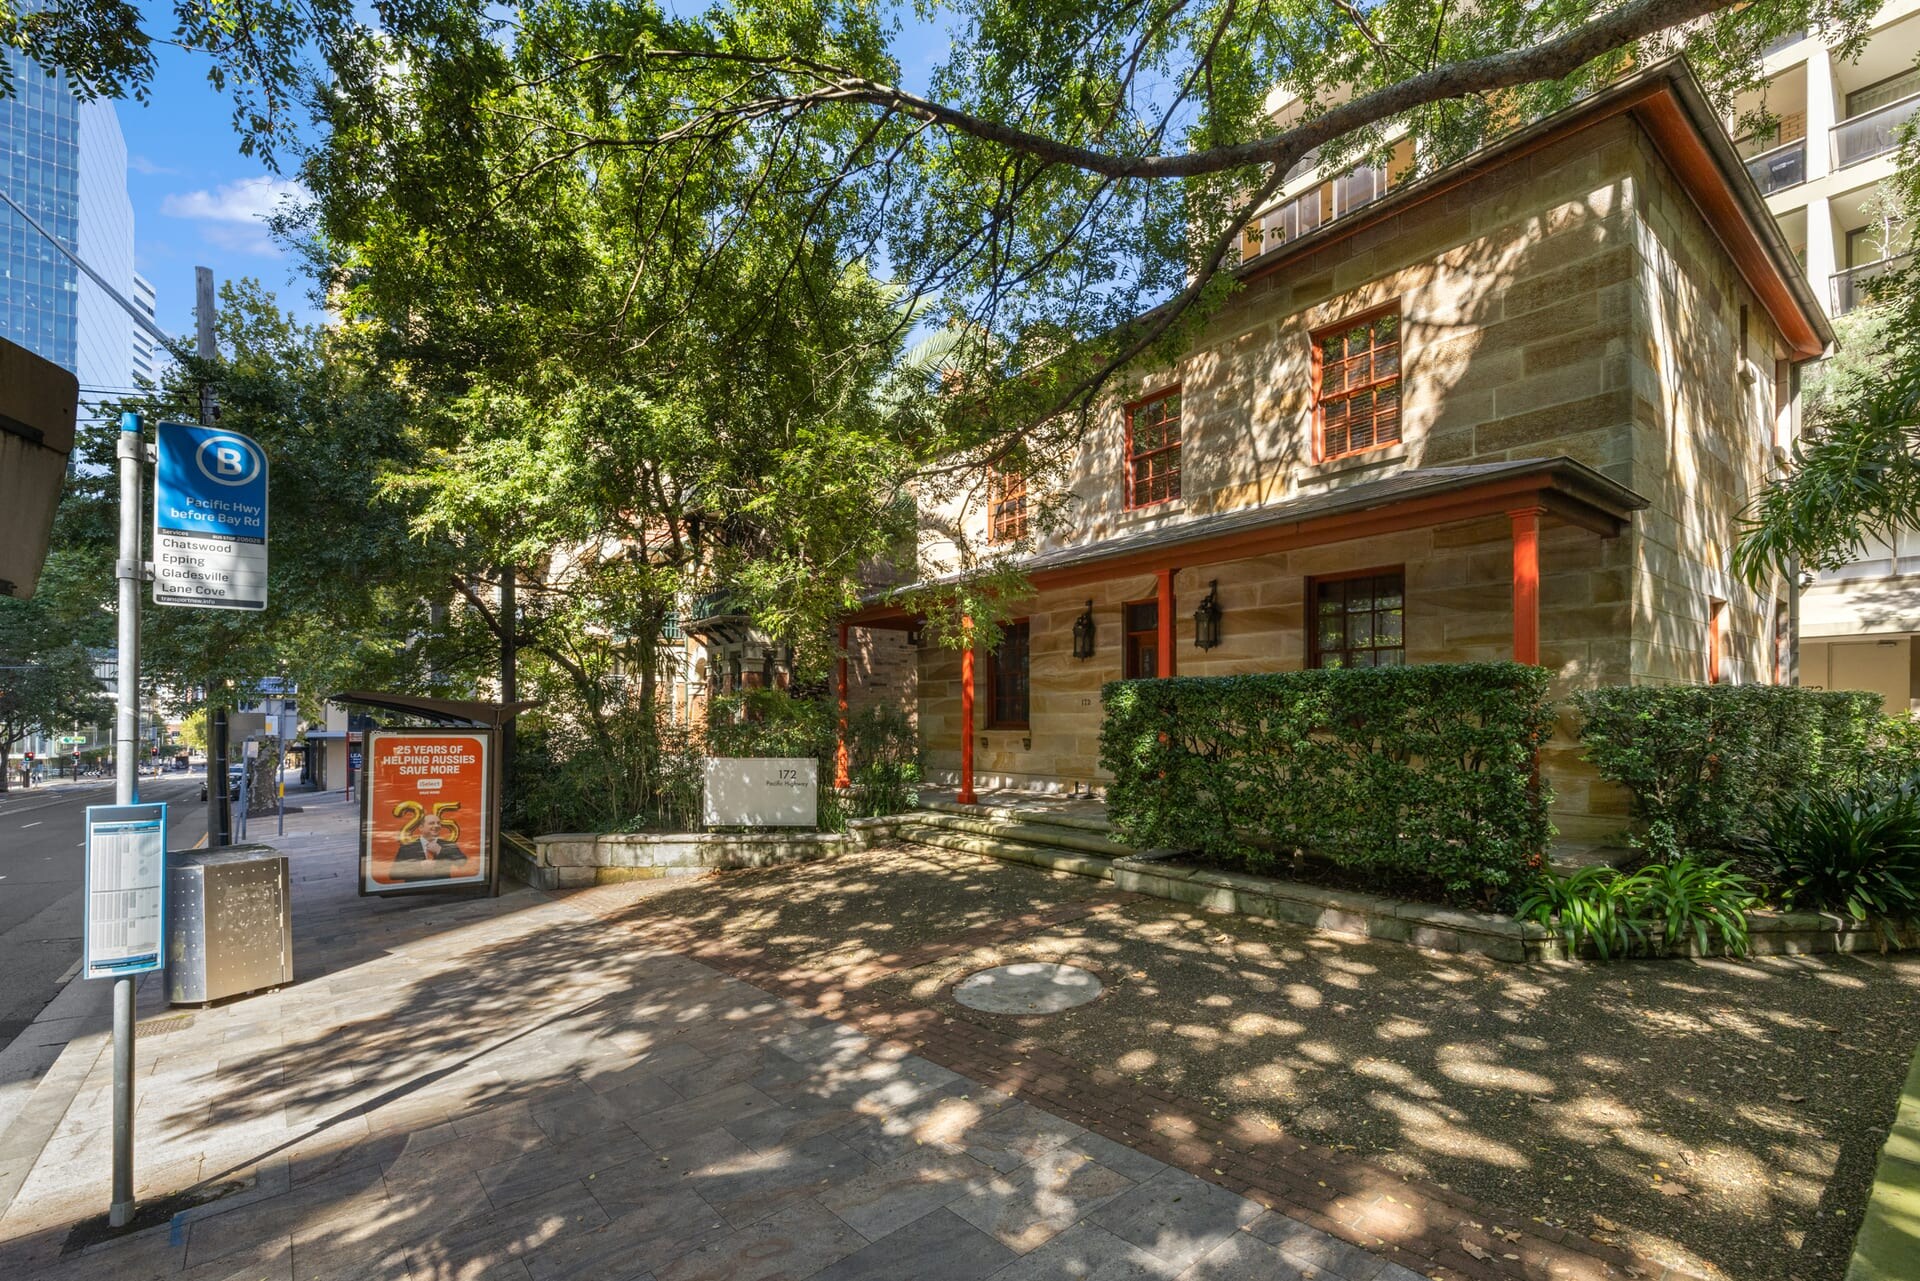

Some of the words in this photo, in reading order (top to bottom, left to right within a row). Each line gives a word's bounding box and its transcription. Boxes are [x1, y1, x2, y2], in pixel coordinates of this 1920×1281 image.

[217, 447, 242, 475] B
[186, 497, 230, 511] Pacific
[233, 502, 260, 516] Hwy
[170, 508, 215, 522] before
[218, 513, 241, 527] Bay
[244, 517, 260, 527] Rd
[162, 529, 189, 537] Services
[162, 538, 232, 553] Chatswood
[162, 553, 205, 567] Epping
[162, 568, 229, 582] Gladesville
[162, 583, 192, 594] Lane
[195, 585, 226, 596] Cove
[397, 745, 411, 755] 25
[413, 745, 448, 755] YEARS
[449, 745, 463, 754] OF
[383, 755, 429, 765] HELPING
[431, 755, 475, 764] AUSSIES
[399, 765, 428, 775] SAVE
[430, 765, 460, 774] MORE
[779, 769, 797, 779] 172
[784, 780, 808, 788] Highway
